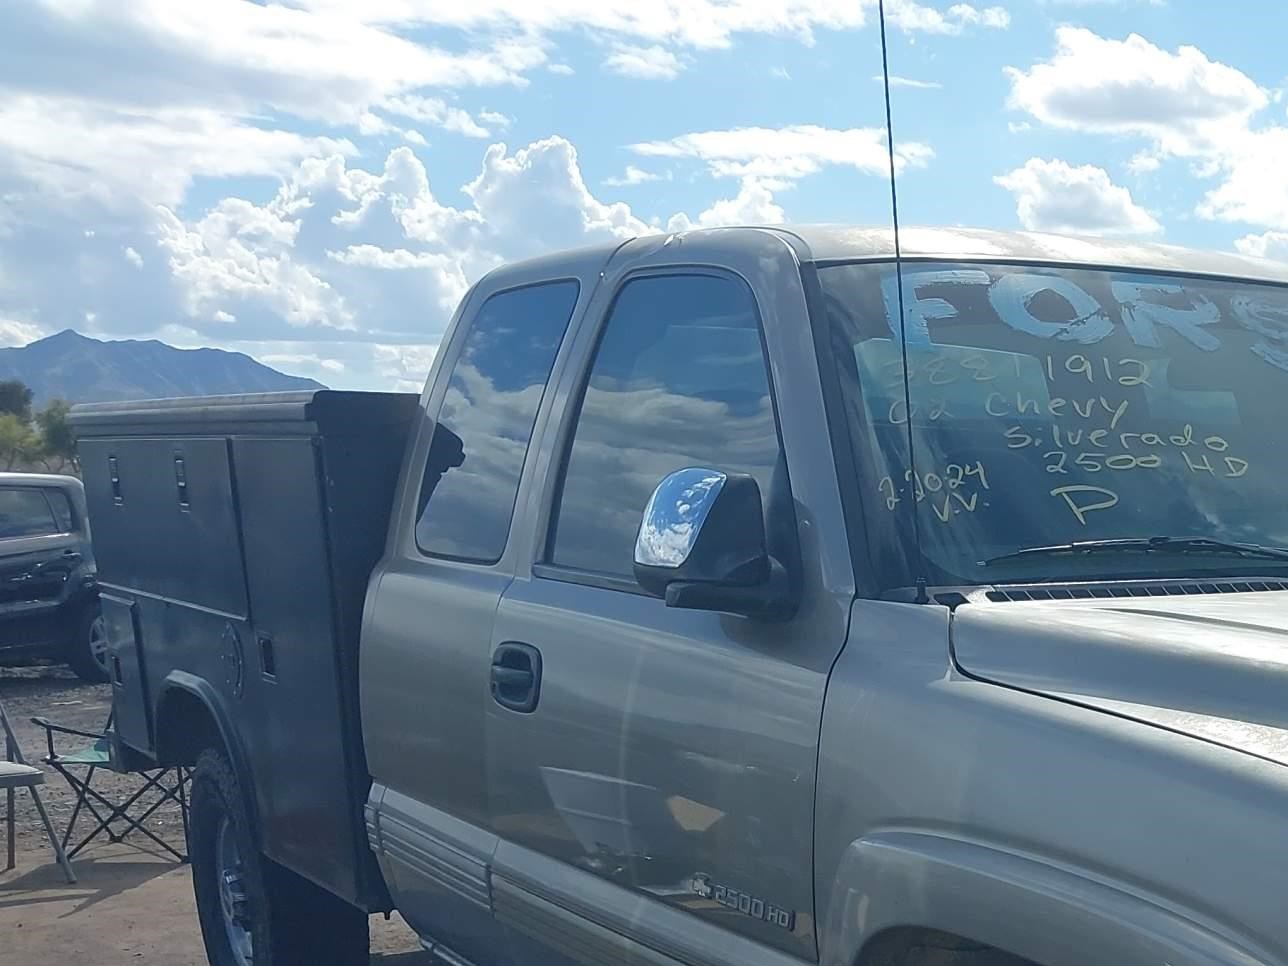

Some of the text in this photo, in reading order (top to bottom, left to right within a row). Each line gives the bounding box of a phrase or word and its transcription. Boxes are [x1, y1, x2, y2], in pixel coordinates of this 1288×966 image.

[884, 353, 1153, 389] 38811912
[889, 391, 1128, 429] 02 Chevy
[1003, 423, 1229, 451] Silverado
[1043, 451, 1162, 474] 2500
[715, 884, 789, 927] 2500 HD
